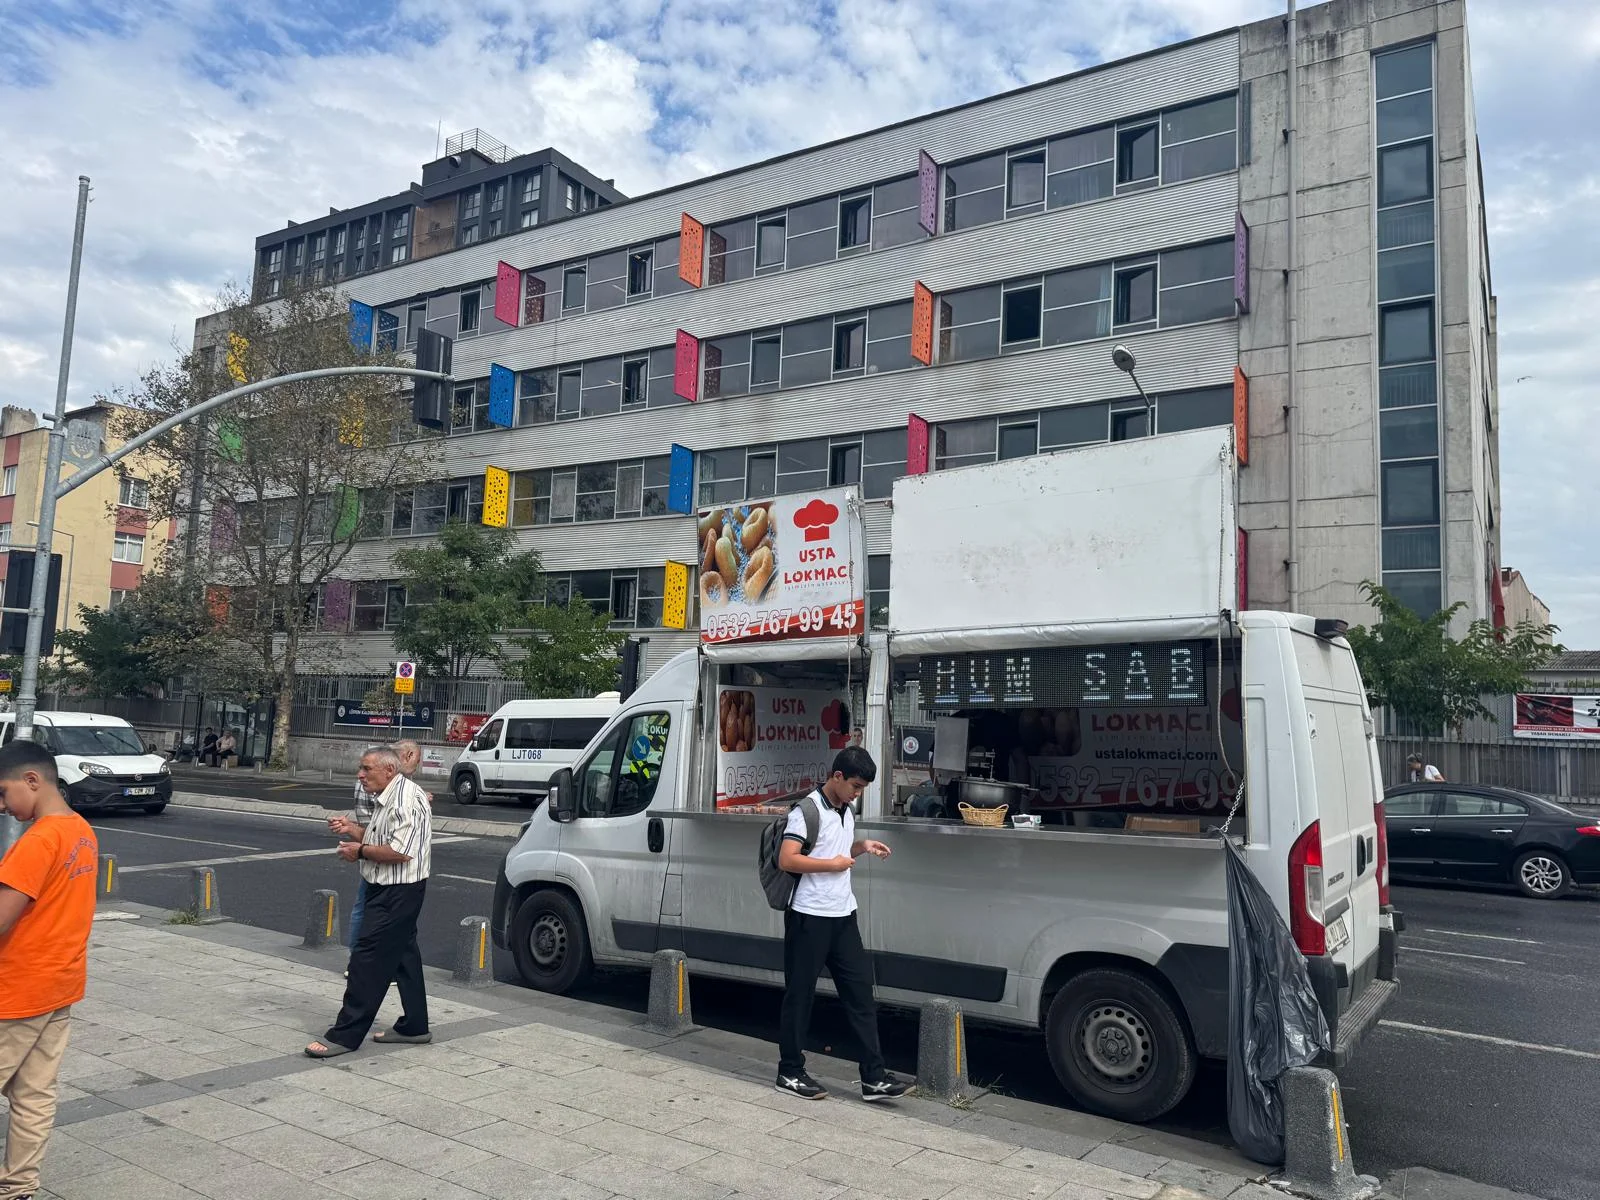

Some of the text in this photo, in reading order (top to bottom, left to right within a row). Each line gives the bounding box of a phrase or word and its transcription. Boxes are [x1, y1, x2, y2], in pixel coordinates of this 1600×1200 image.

[799, 547, 836, 563] USTA
[784, 565, 854, 584] LOKMAC
[707, 603, 857, 640] 0532 767 99 45
[772, 698, 806, 715] USTA
[1092, 713, 1212, 733] LOKMACI
[757, 724, 820, 742] LOKMACI
[1095, 748, 1218, 761] ustalokmaci.com
[725, 764, 768, 798] 0532
[774, 763, 806, 793] 767
[1112, 766, 1183, 807] 767
[1194, 767, 1243, 810] 99
